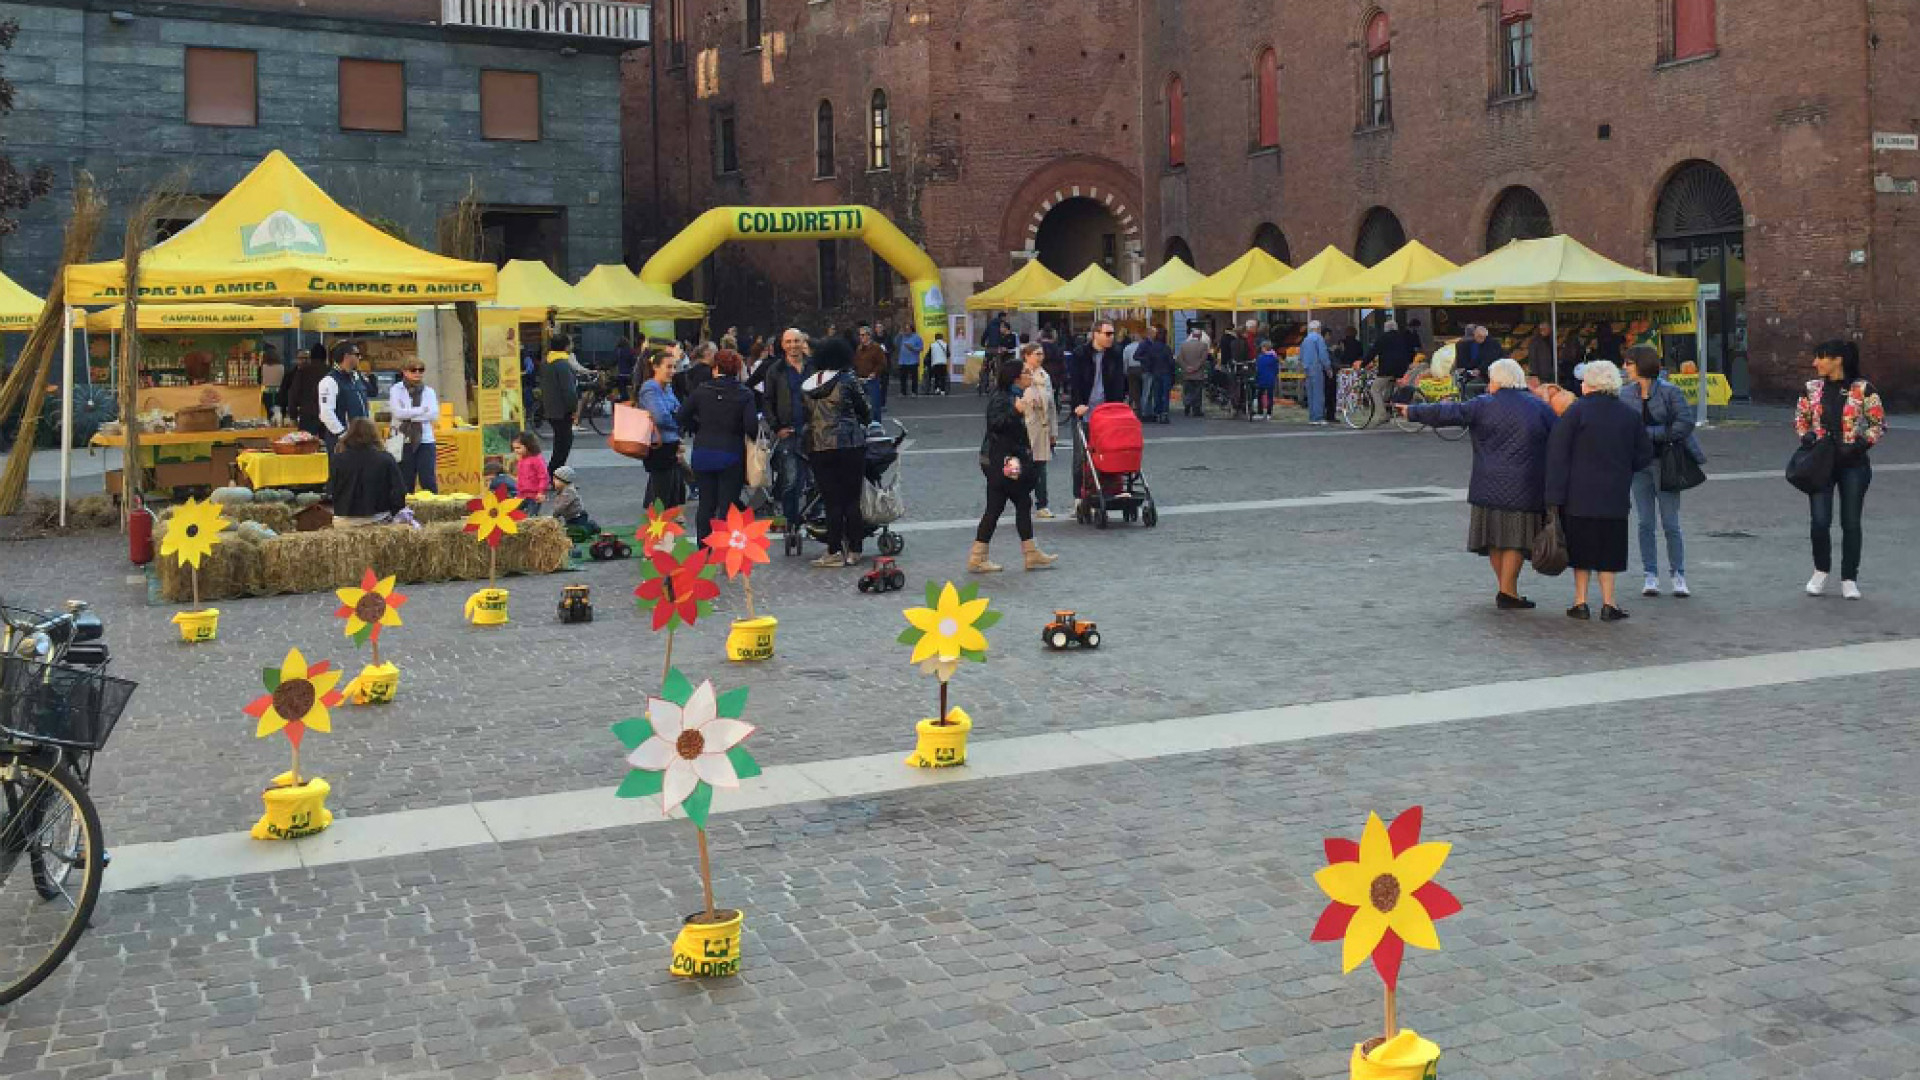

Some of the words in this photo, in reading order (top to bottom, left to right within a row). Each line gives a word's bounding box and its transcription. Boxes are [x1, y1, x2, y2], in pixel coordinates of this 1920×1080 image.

[738, 209, 863, 233] COLDIRETTI
[214, 281, 277, 294] AMICA
[426, 283, 484, 293] AMICA
[223, 314, 254, 323] AMICA
